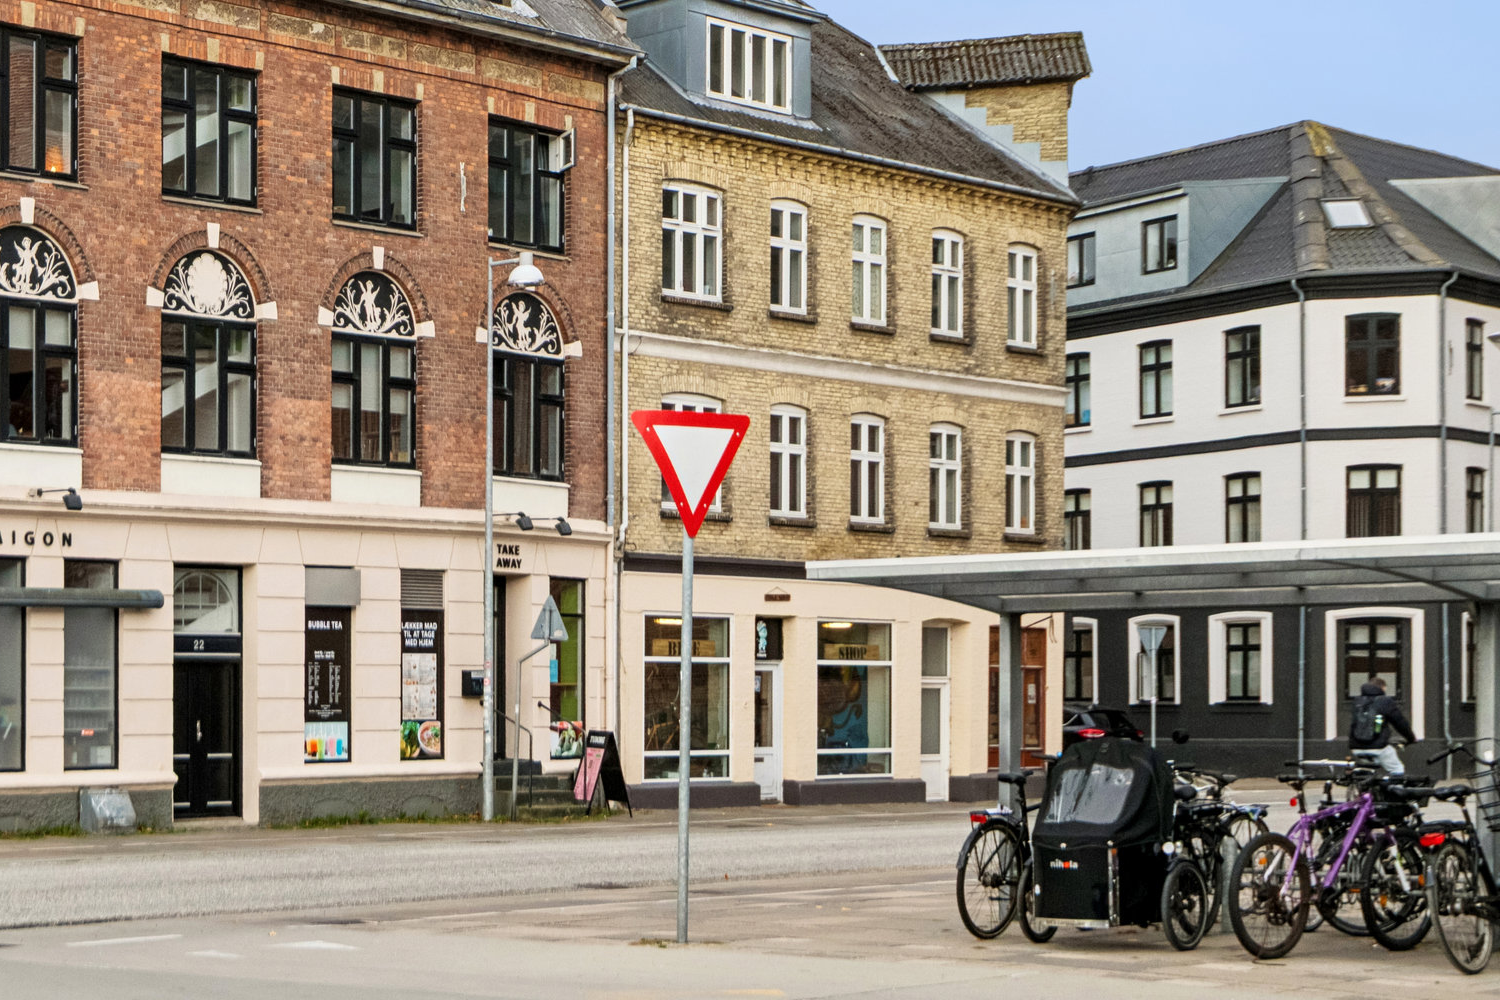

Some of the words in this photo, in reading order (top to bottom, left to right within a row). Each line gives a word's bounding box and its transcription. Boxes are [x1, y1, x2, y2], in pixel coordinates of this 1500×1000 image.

[496, 544, 520, 555] TAKE
[496, 557, 522, 569] AWAY
[308, 620, 330, 630] BUBBLE
[331, 620, 343, 630] TEA
[424, 622, 438, 630] MAD
[404, 630, 412, 638] TIL
[413, 630, 420, 638] AT
[421, 630, 435, 639] TAGE
[193, 639, 204, 651] 22
[405, 638, 417, 647] MED
[419, 638, 434, 647] HJEM
[839, 646, 867, 660] SHOP
[1050, 858, 1078, 869] nihola
